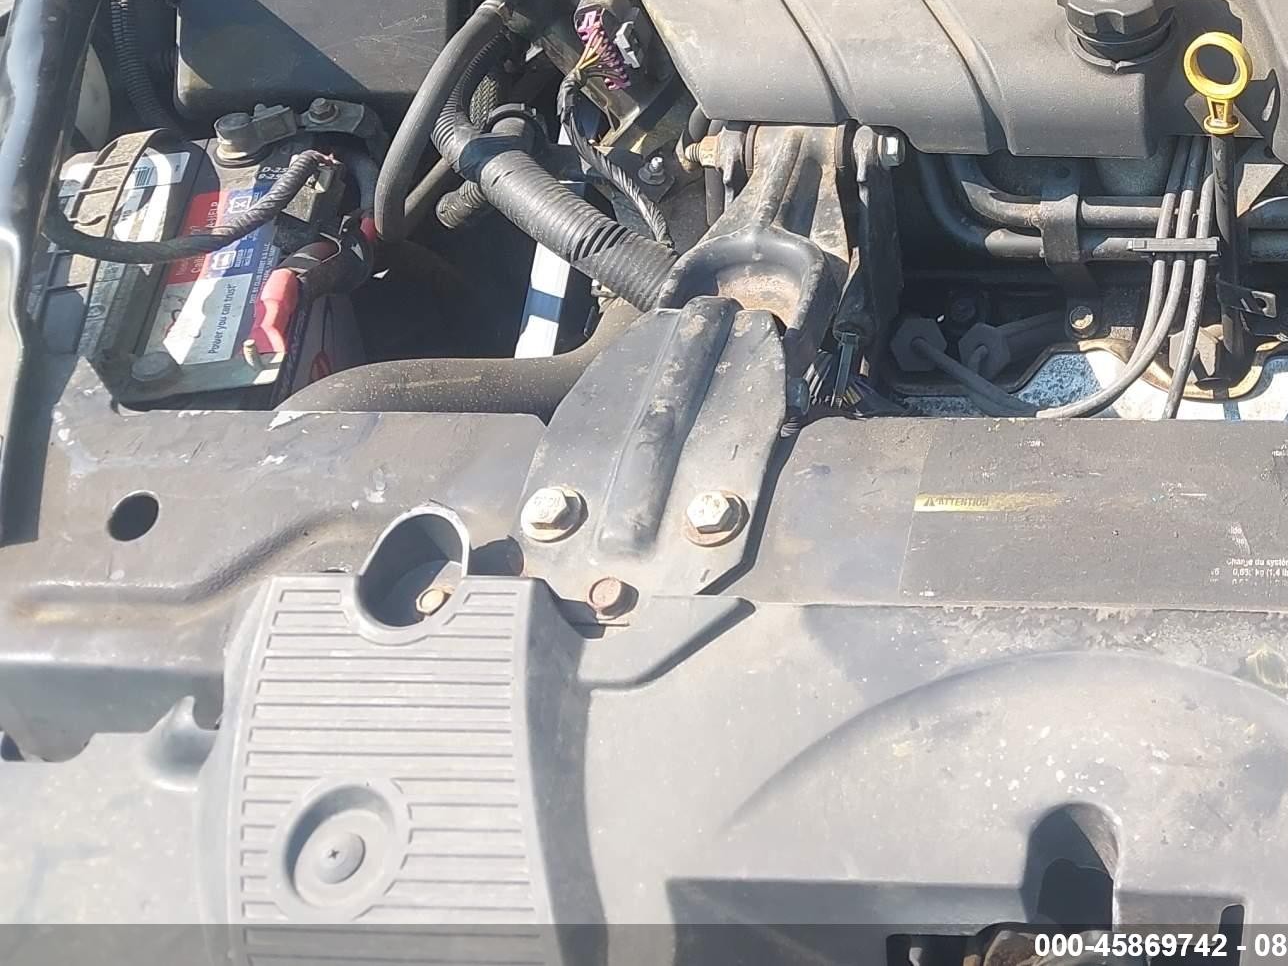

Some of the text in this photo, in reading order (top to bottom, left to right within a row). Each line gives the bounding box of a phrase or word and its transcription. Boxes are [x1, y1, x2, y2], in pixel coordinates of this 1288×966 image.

[208, 283, 238, 354] Power you can trust
[936, 496, 989, 507] ATTENTION
[1254, 558, 1265, 566] du
